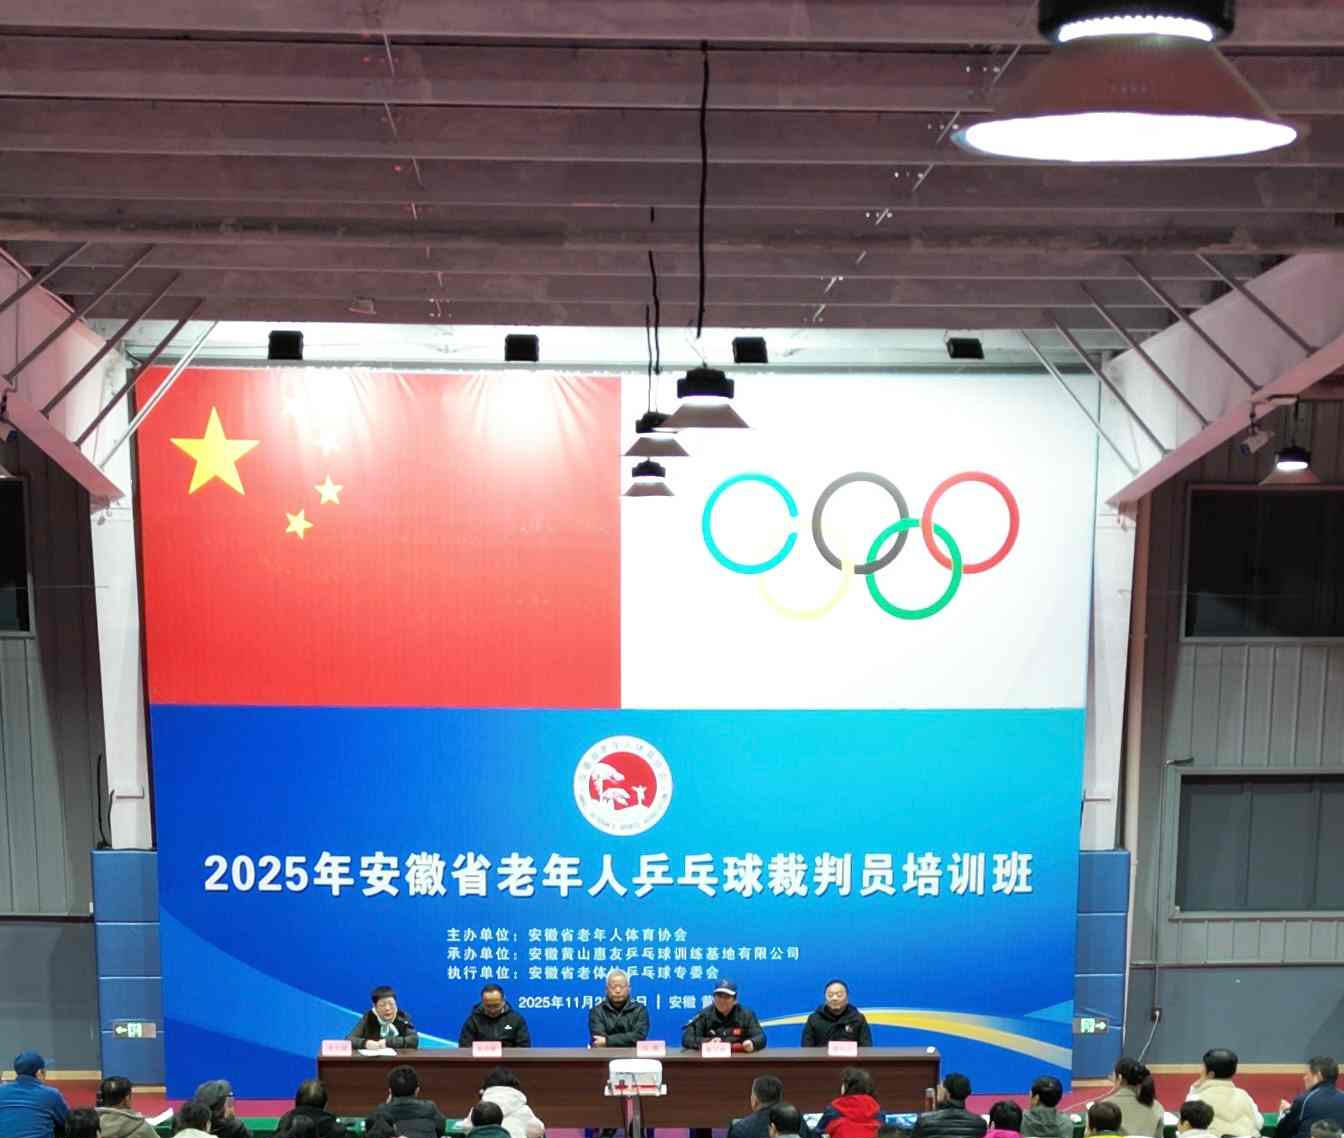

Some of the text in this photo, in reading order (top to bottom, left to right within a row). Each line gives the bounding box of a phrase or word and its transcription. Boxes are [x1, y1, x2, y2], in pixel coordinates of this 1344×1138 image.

[203, 851, 1033, 897] 2025年安徽省老年人乒乓球裁判员培训班
[669, 995, 696, 1009] 安徽
